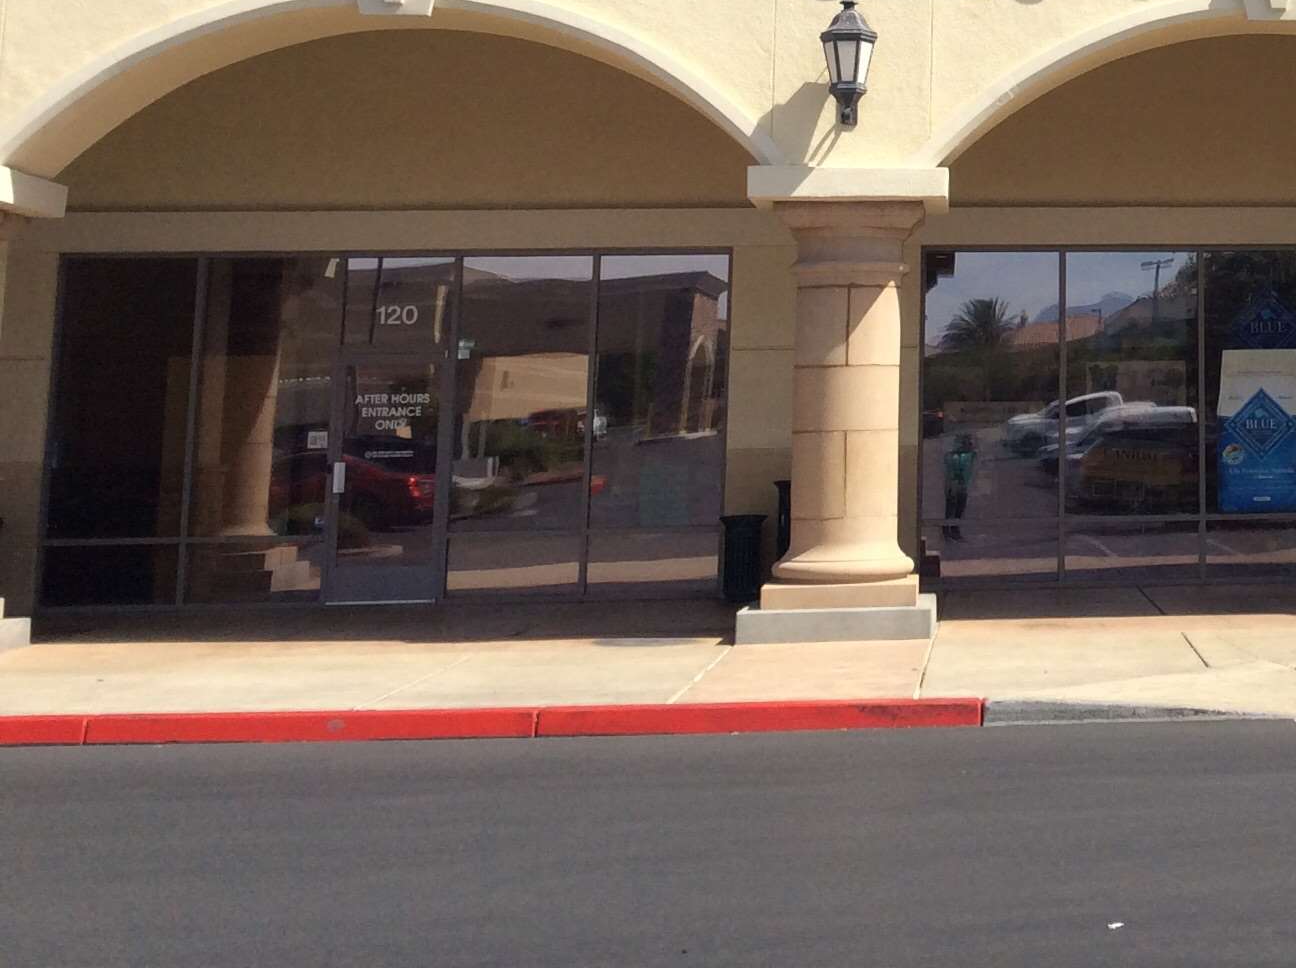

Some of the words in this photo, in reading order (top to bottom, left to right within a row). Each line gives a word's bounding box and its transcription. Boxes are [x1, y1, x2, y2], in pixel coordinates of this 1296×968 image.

[375, 304, 418, 325] 120
[355, 393, 388, 404] AFTER
[391, 393, 431, 404] HOURS
[361, 406, 422, 417] ENTRANCE
[1245, 418, 1277, 430] BLUE
